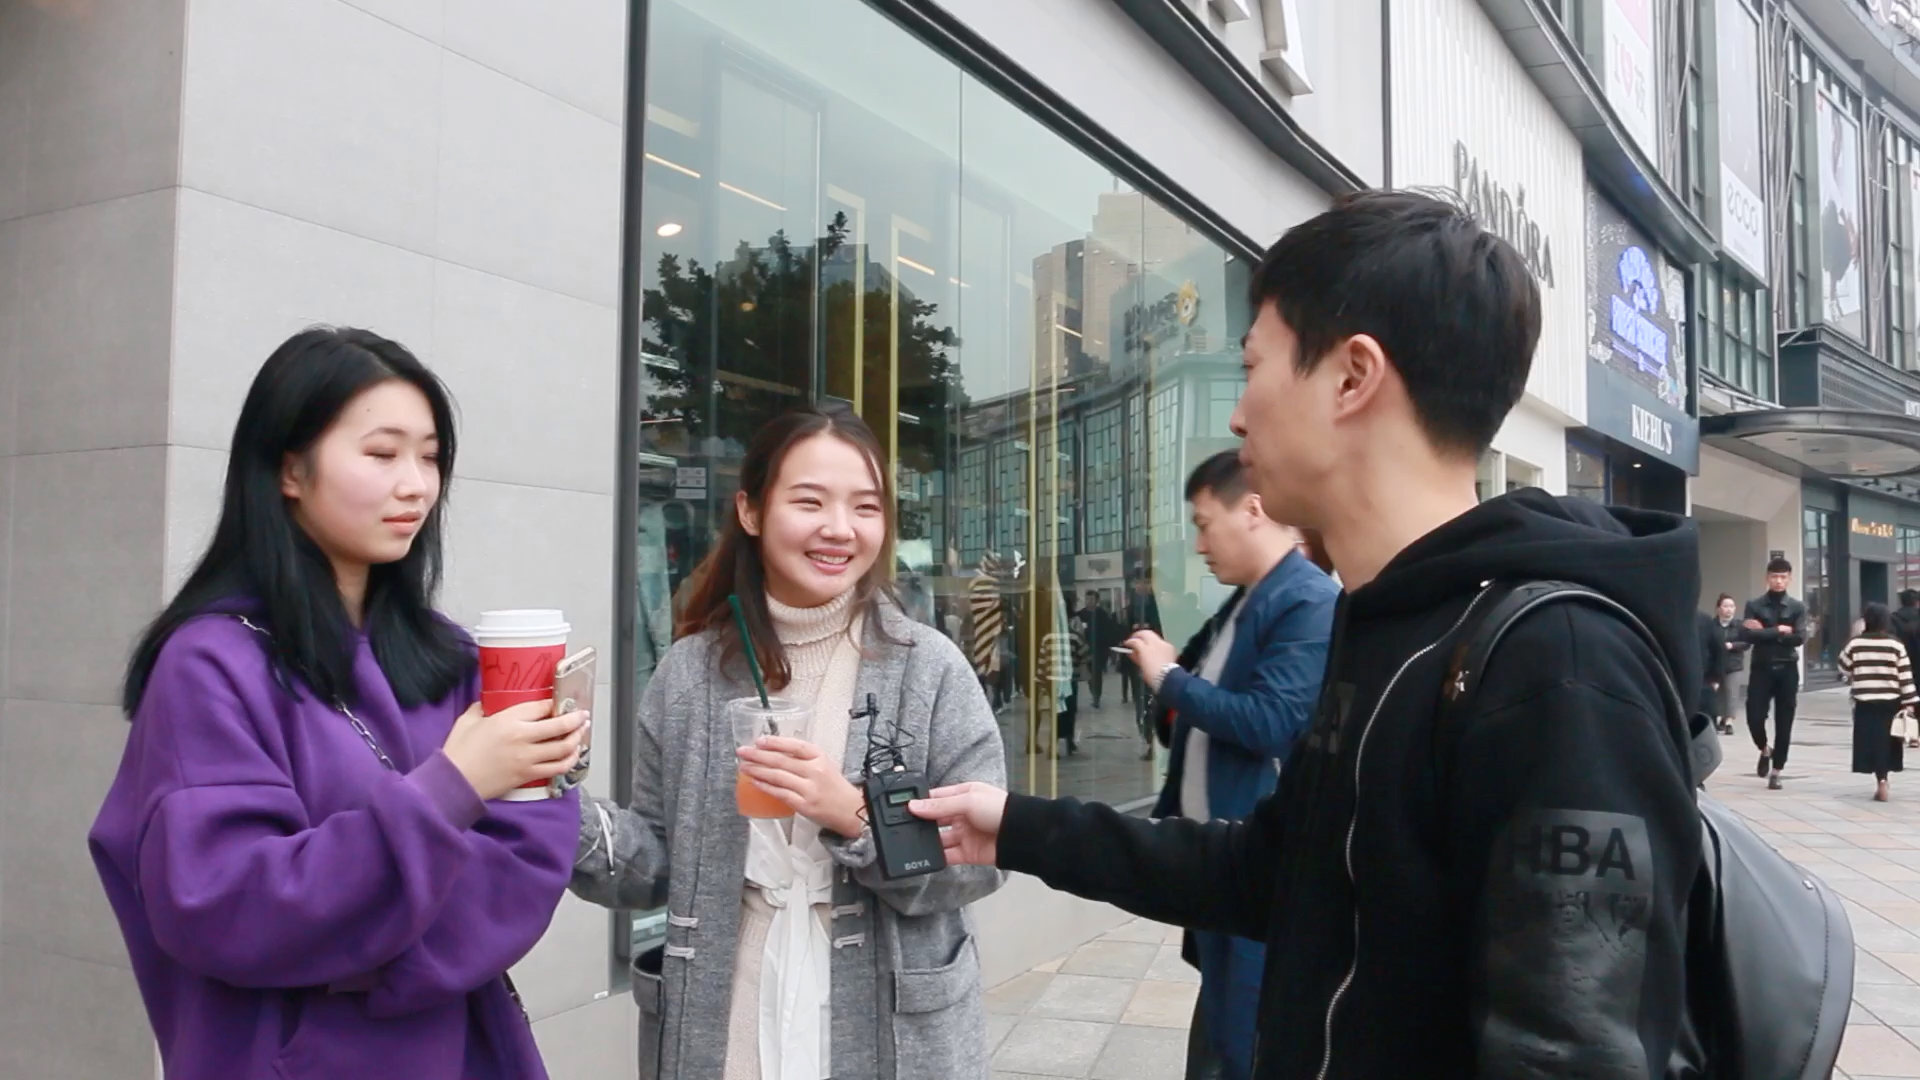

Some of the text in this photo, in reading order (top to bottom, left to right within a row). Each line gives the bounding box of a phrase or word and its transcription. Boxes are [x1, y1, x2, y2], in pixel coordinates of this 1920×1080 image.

[1631, 403, 1673, 455] KIEHL'S
[904, 859, 931, 871] BOYA
[1506, 823, 1637, 881] HBA
